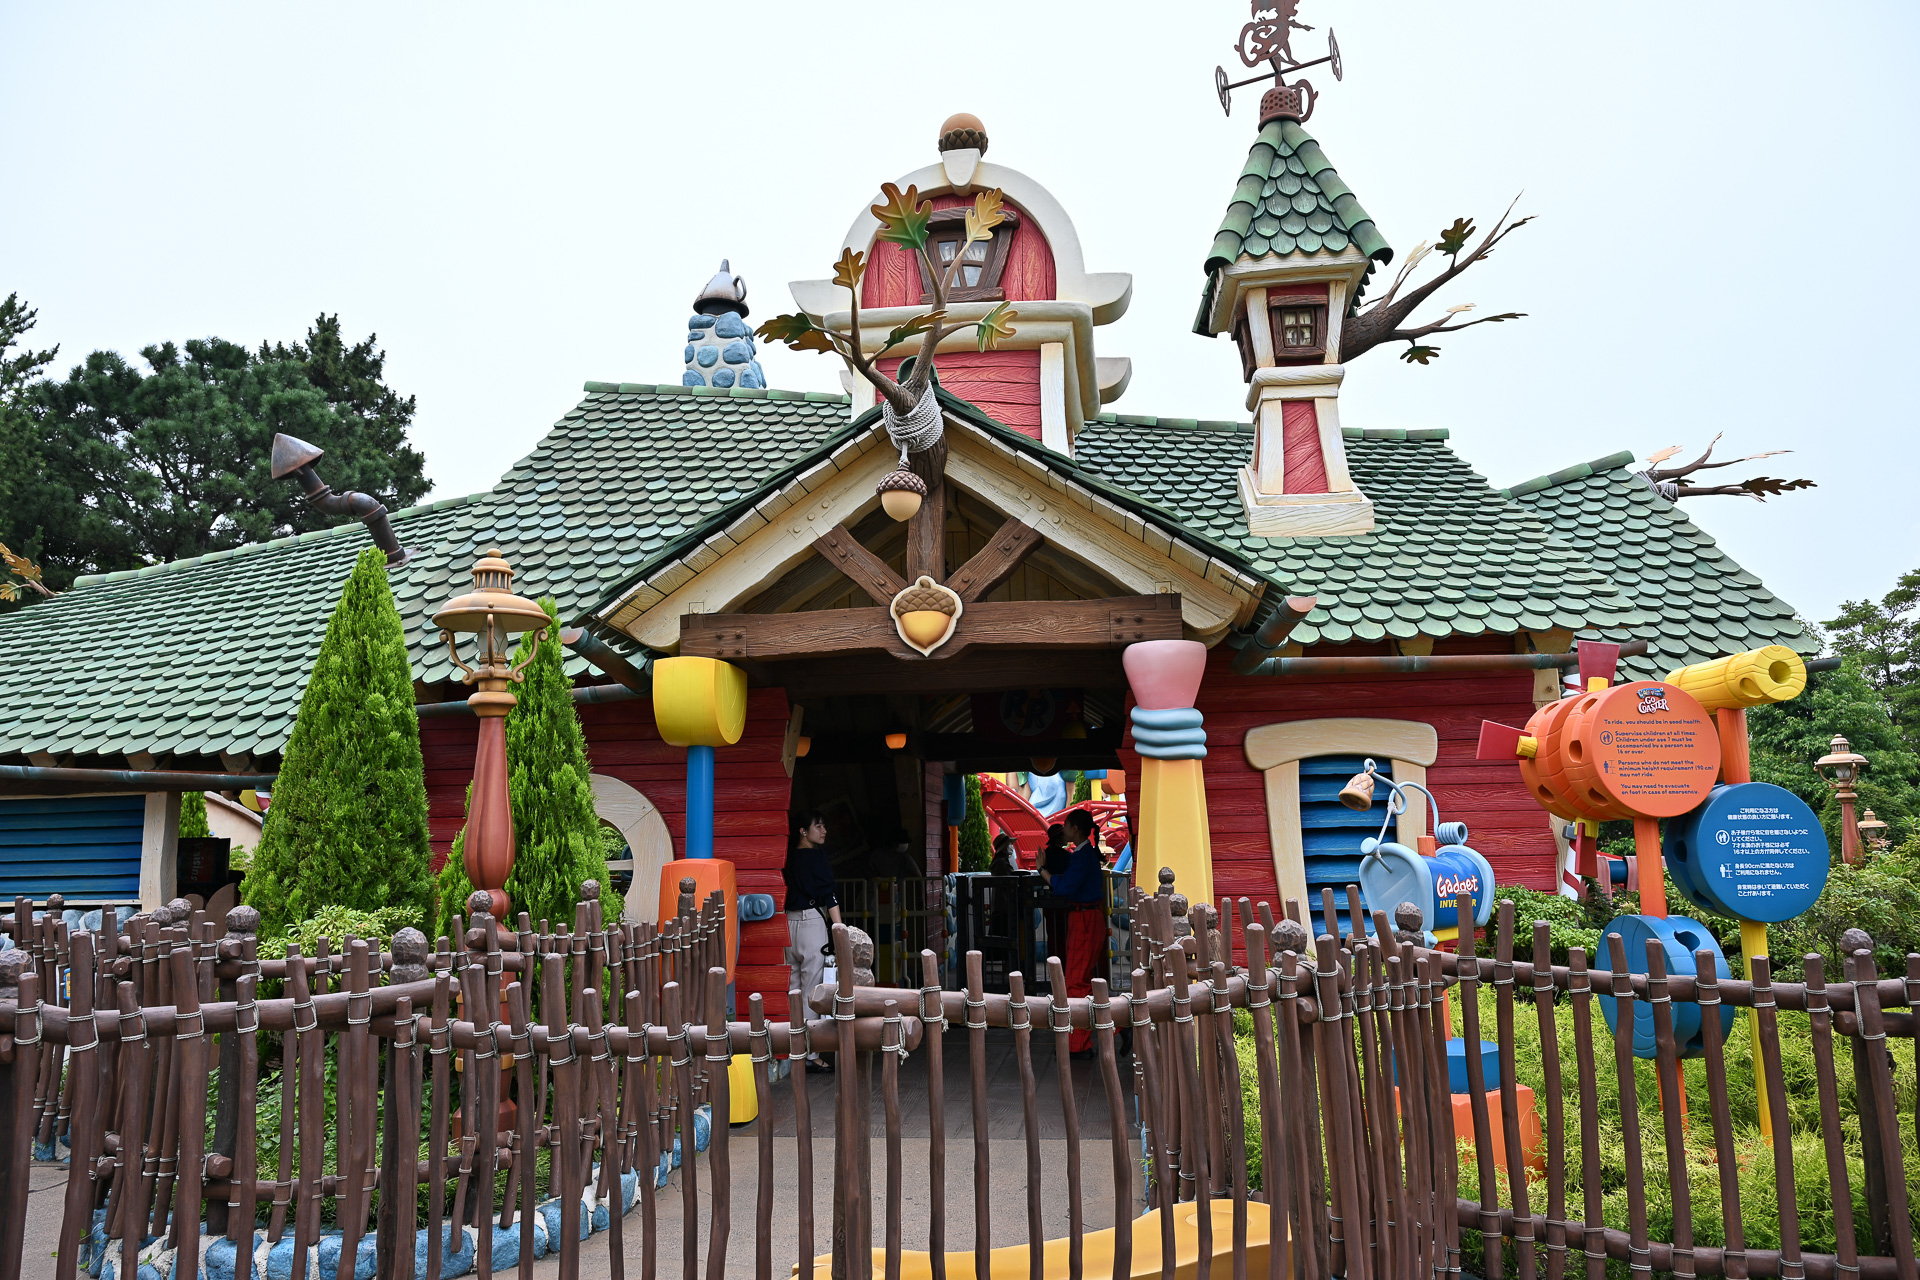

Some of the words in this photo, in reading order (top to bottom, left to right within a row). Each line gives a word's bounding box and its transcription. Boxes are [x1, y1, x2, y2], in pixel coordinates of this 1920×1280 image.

[1638, 698, 1669, 714] COASTER
[1645, 696, 1655, 705] GO
[1440, 898, 1477, 909] INVER
